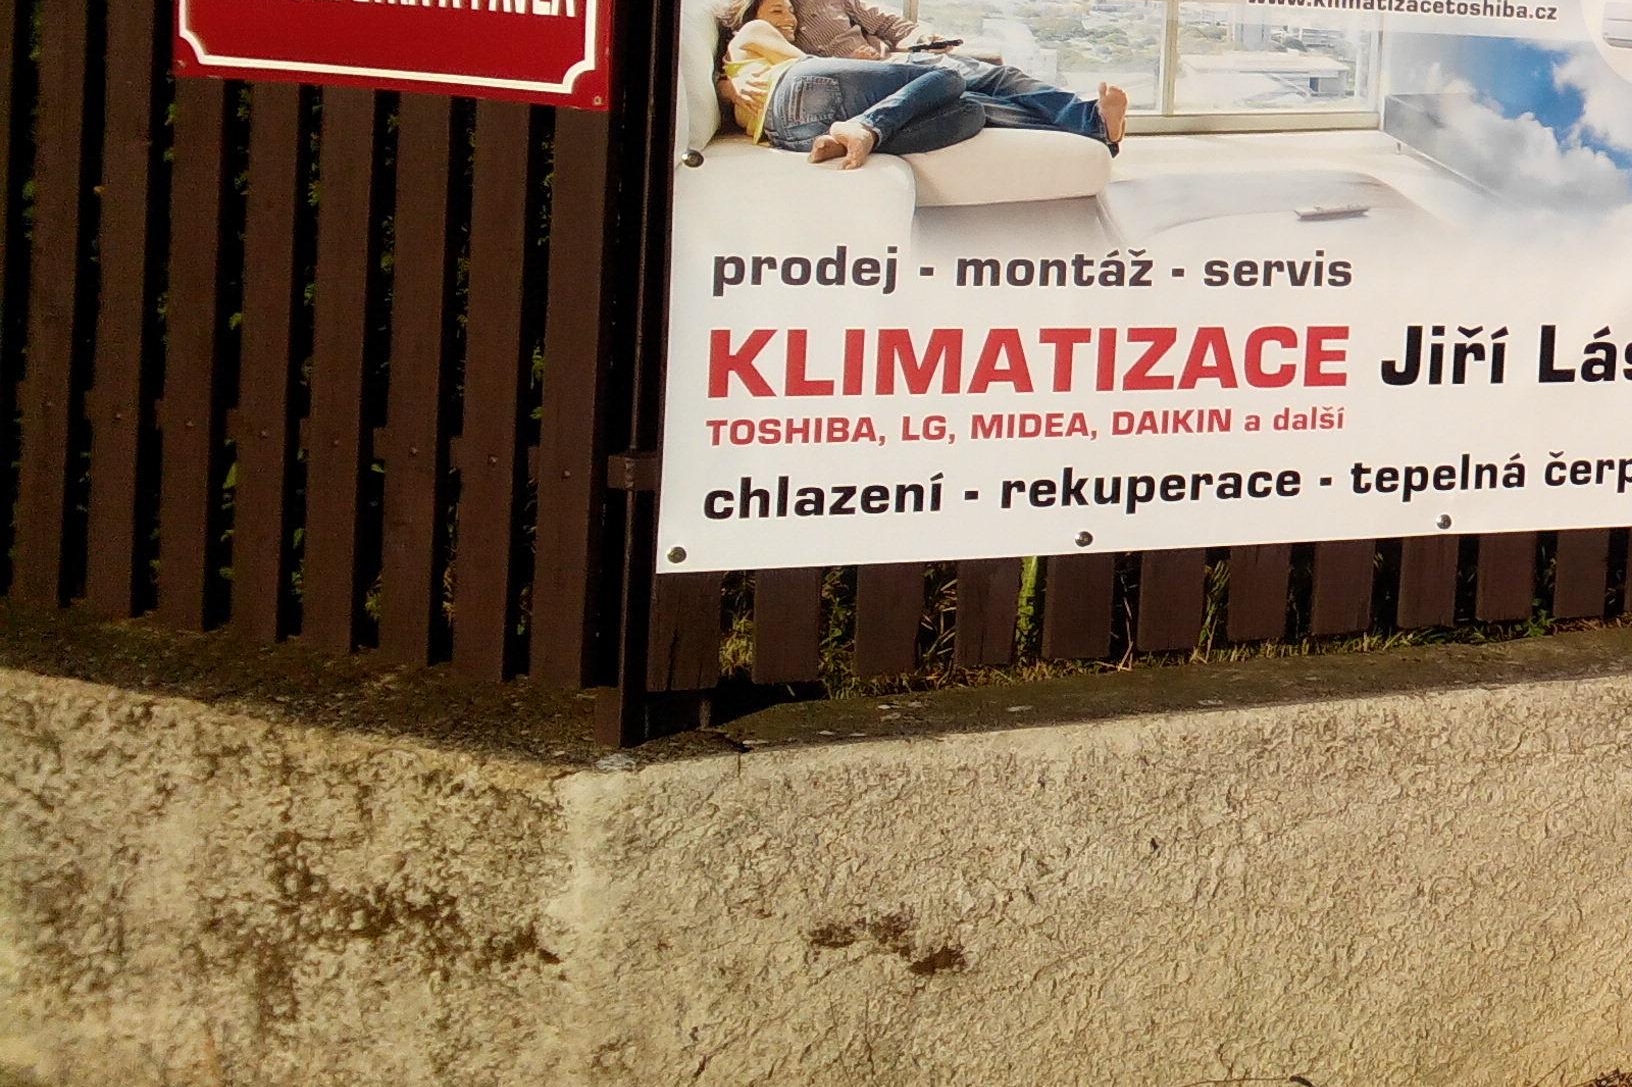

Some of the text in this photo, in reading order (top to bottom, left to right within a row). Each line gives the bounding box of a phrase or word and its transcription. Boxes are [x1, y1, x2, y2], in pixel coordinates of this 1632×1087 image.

[713, 246, 897, 296] prodej
[957, 250, 1153, 286] montáž
[1204, 250, 1351, 286] servis
[708, 326, 1349, 397] KLIMATIZACE
[1381, 326, 1508, 385] Jiří
[706, 408, 1344, 445] TOSHIBA, LG, MIDEA, DAIKIN a další
[704, 473, 943, 519] chlazení
[1002, 467, 1300, 514] rekuperace
[1351, 454, 1525, 502] tepelná
